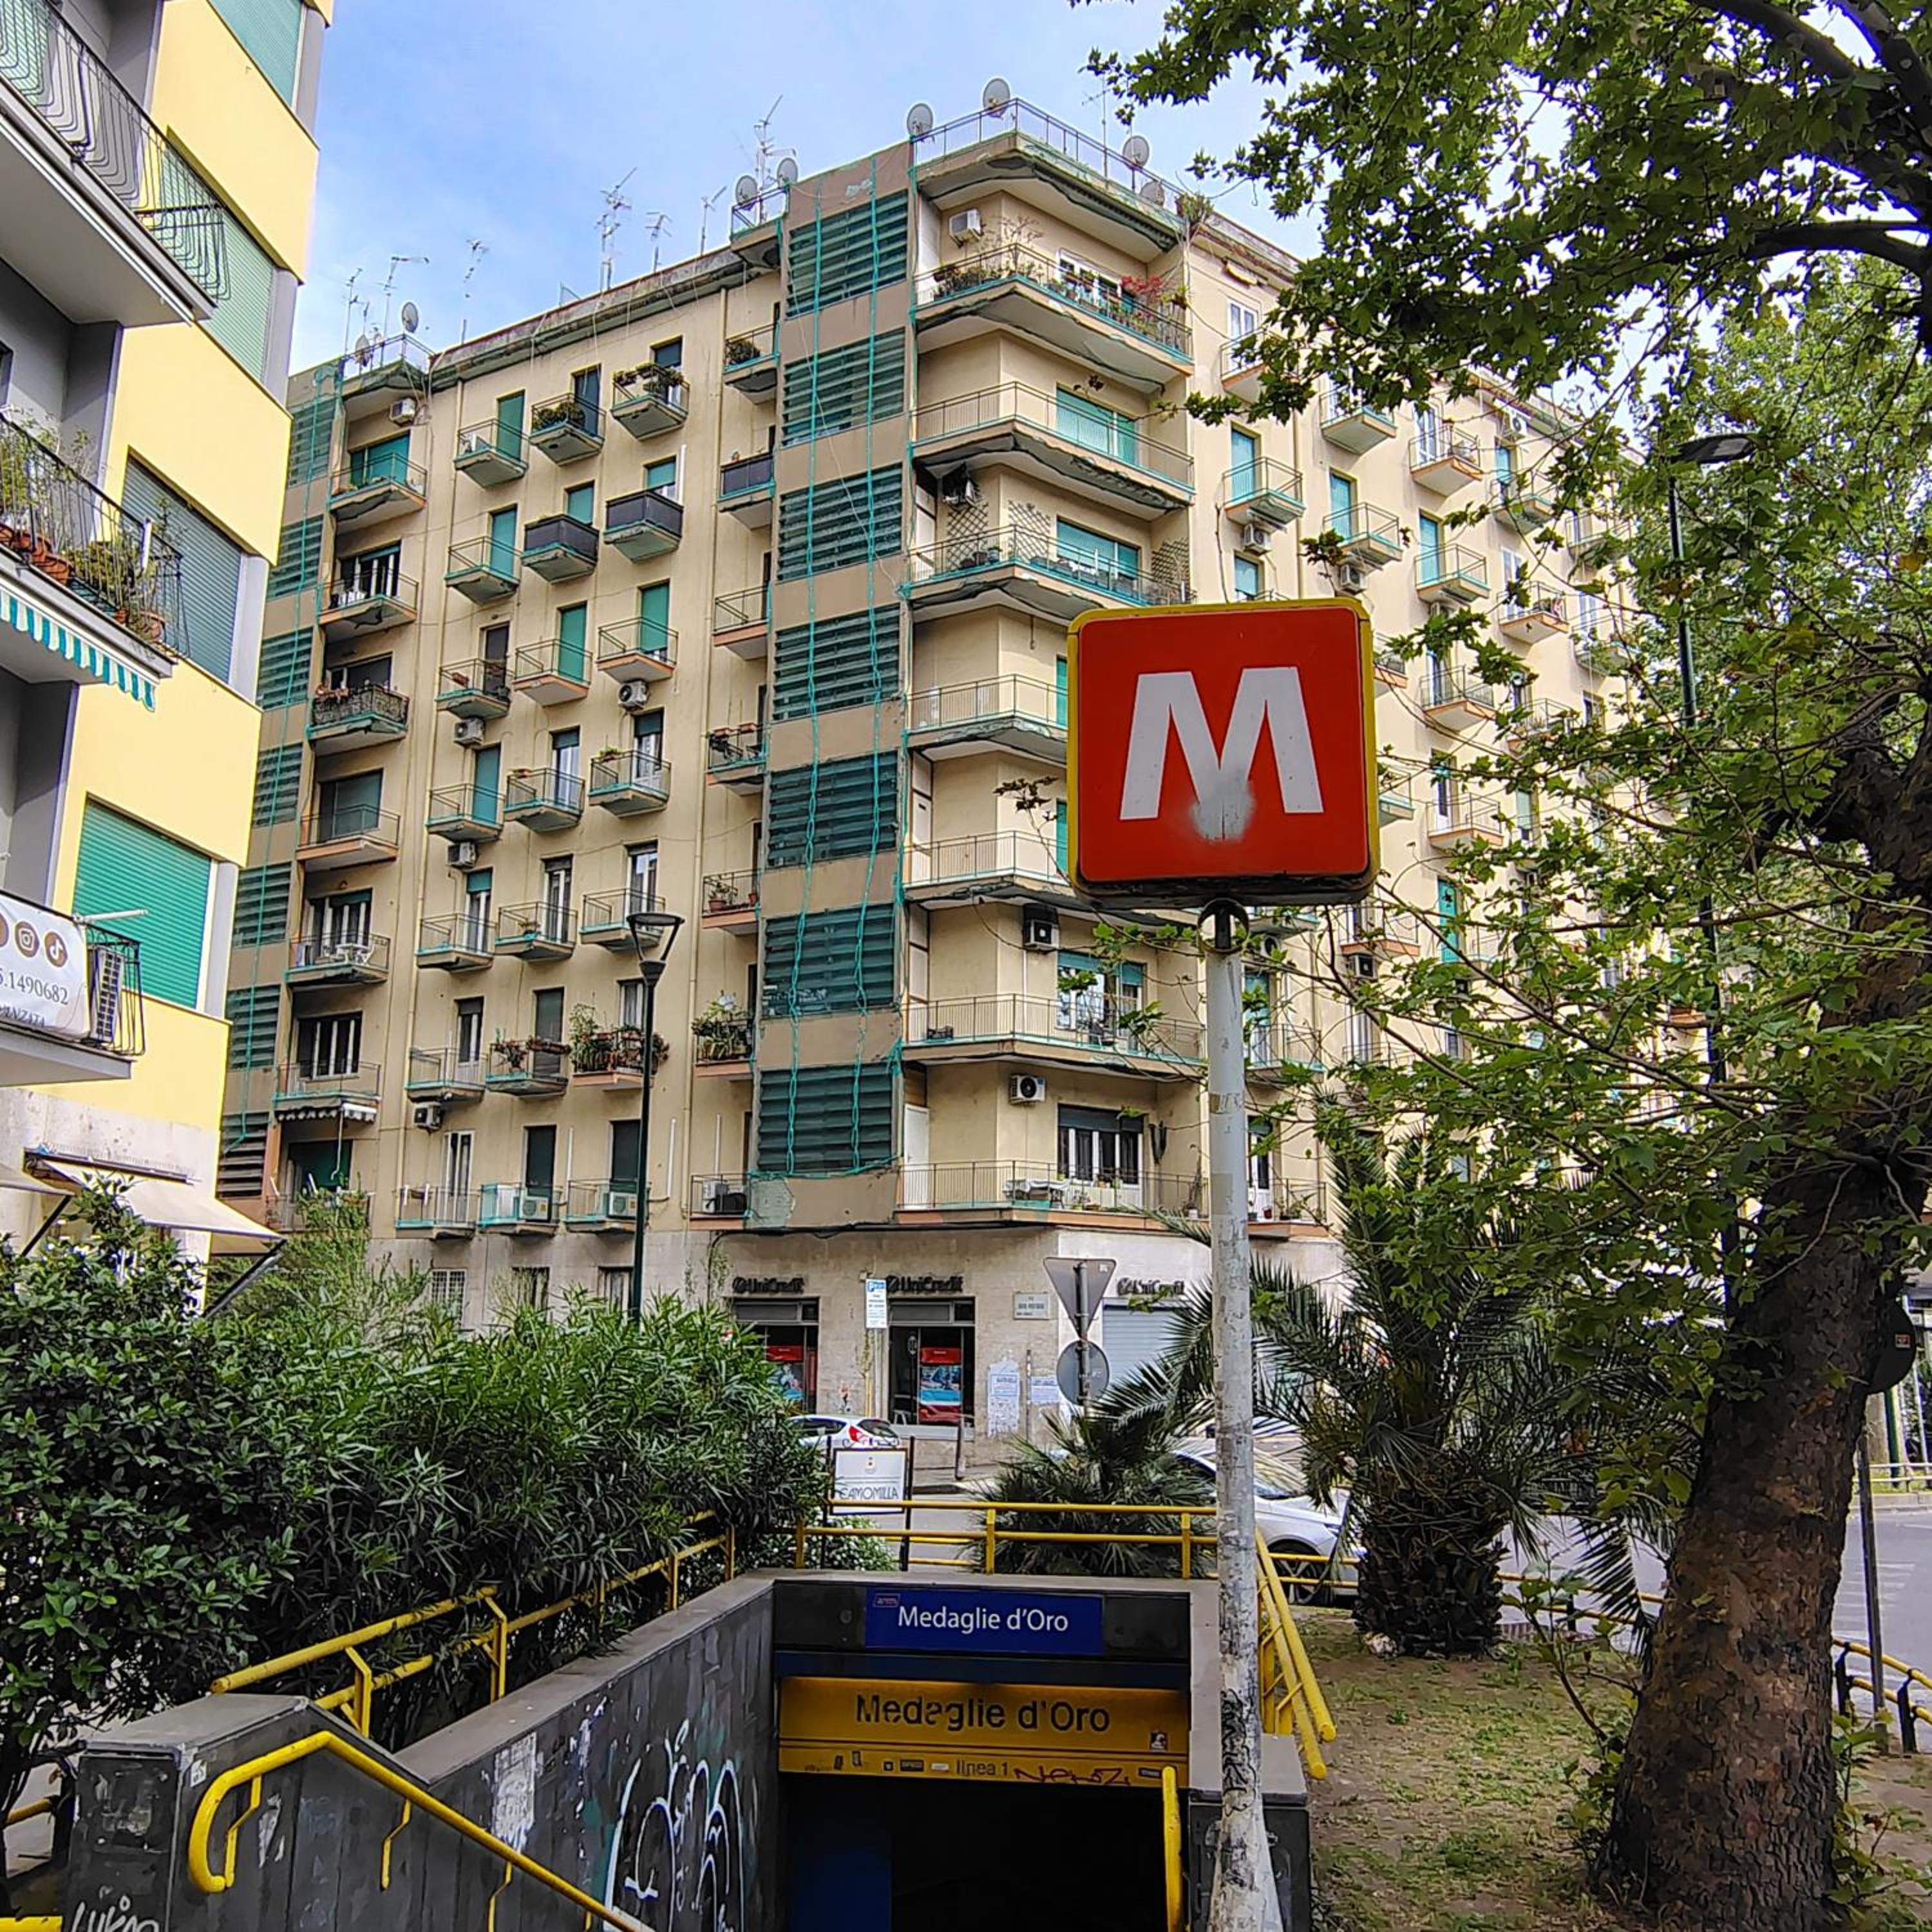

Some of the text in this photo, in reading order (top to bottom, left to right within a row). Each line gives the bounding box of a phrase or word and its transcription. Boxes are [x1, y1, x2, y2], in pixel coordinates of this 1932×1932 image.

[1120, 666, 1324, 821] M
[898, 1605, 1068, 1634] Medaglie d'Oro
[857, 1694, 1110, 1732] Medaglie d'Oro
[1001, 1761, 1008, 1776] 1
